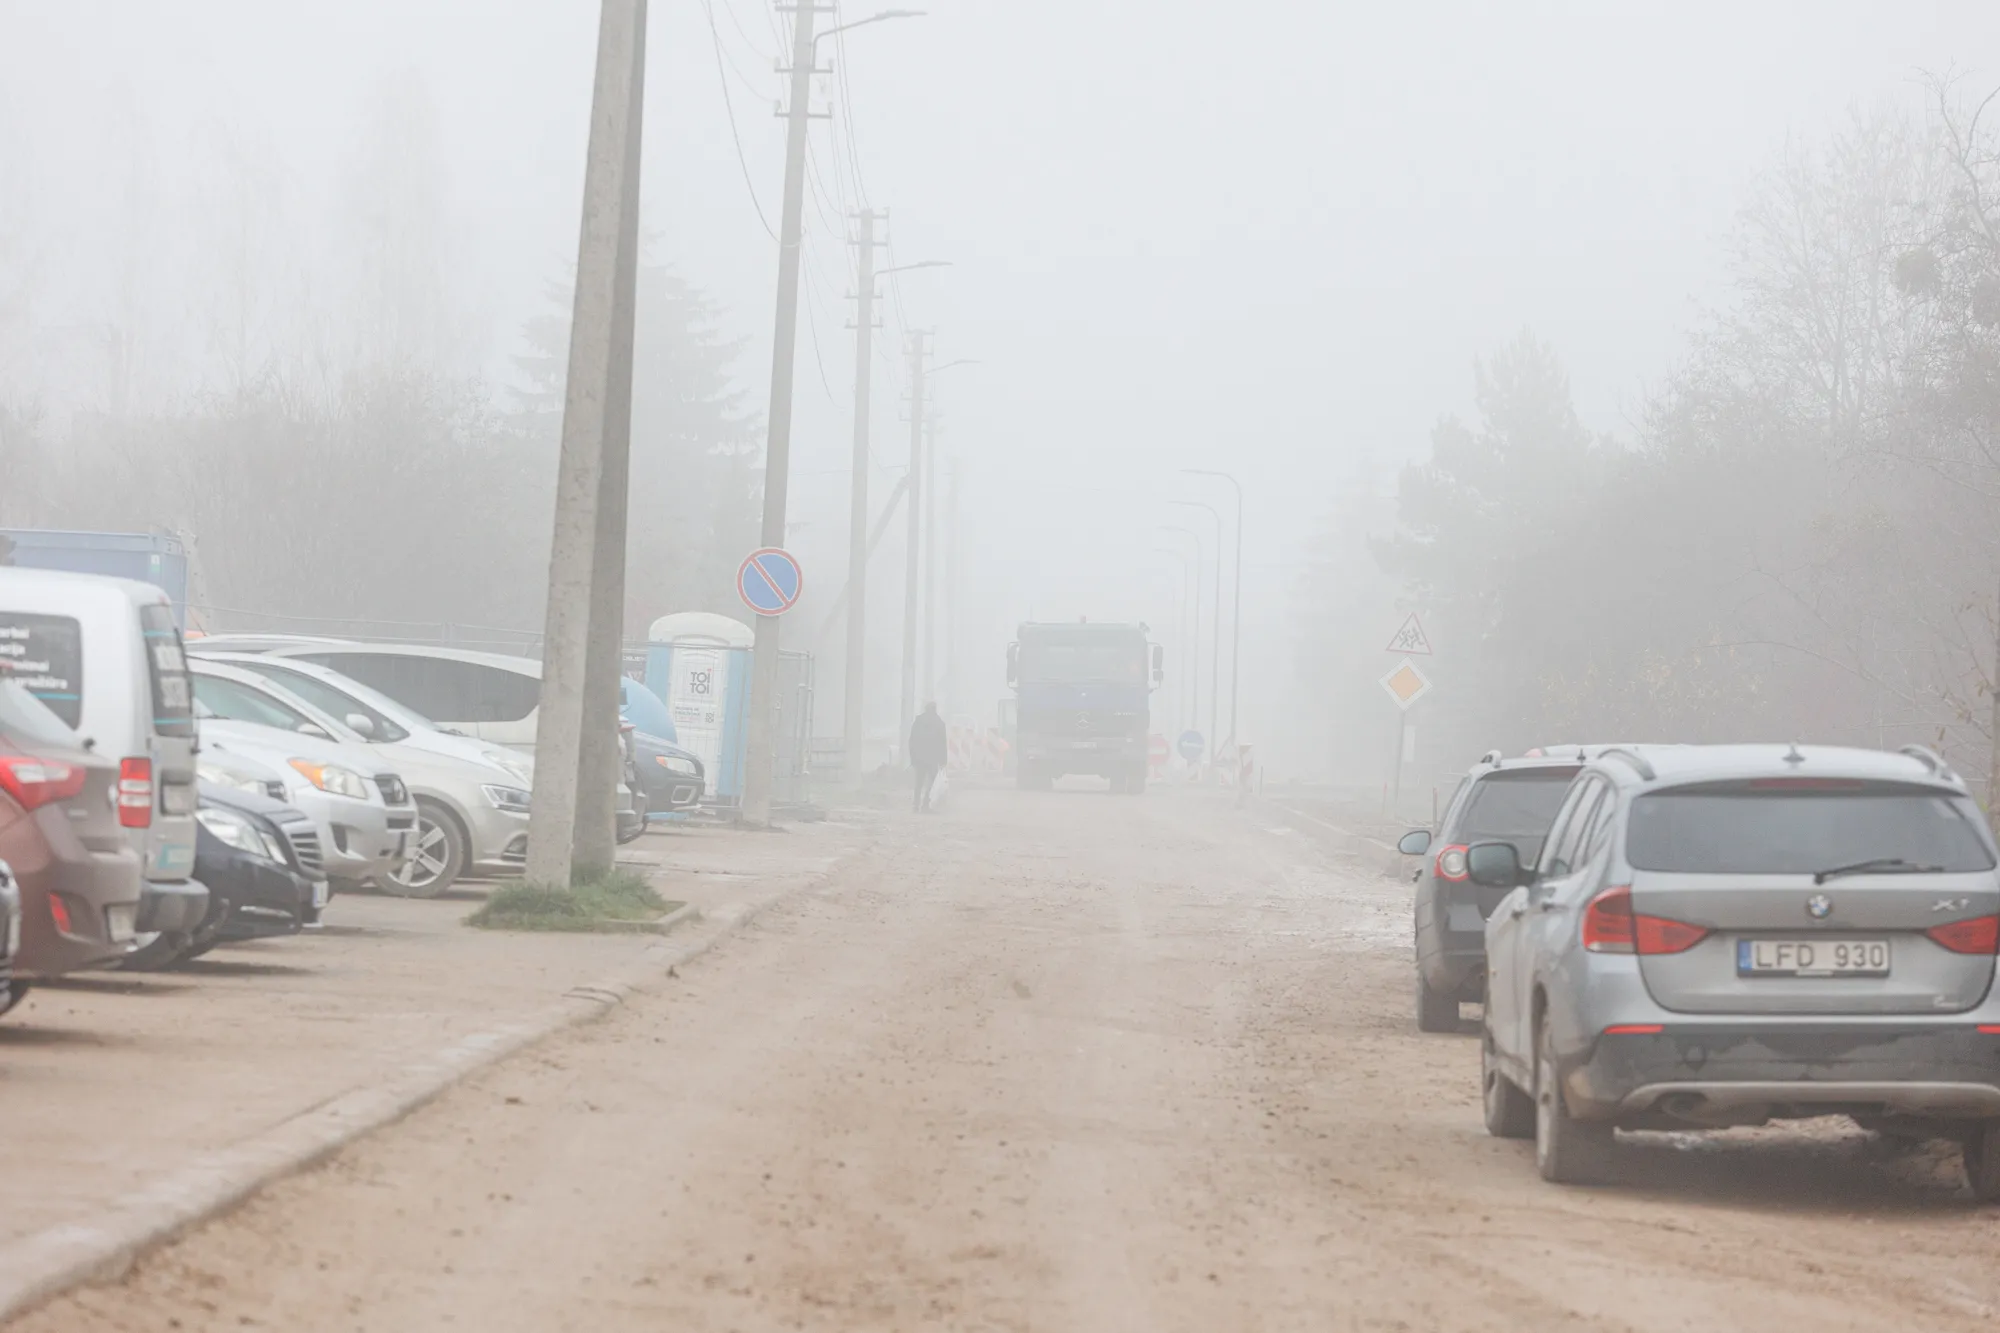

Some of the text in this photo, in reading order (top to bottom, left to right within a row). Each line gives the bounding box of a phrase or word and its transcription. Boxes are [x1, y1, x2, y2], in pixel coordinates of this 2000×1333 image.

[691, 668, 711, 684] TOI
[689, 683, 710, 695] TOI
[1756, 944, 1815, 968] LFD
[1834, 944, 1885, 968] 930
